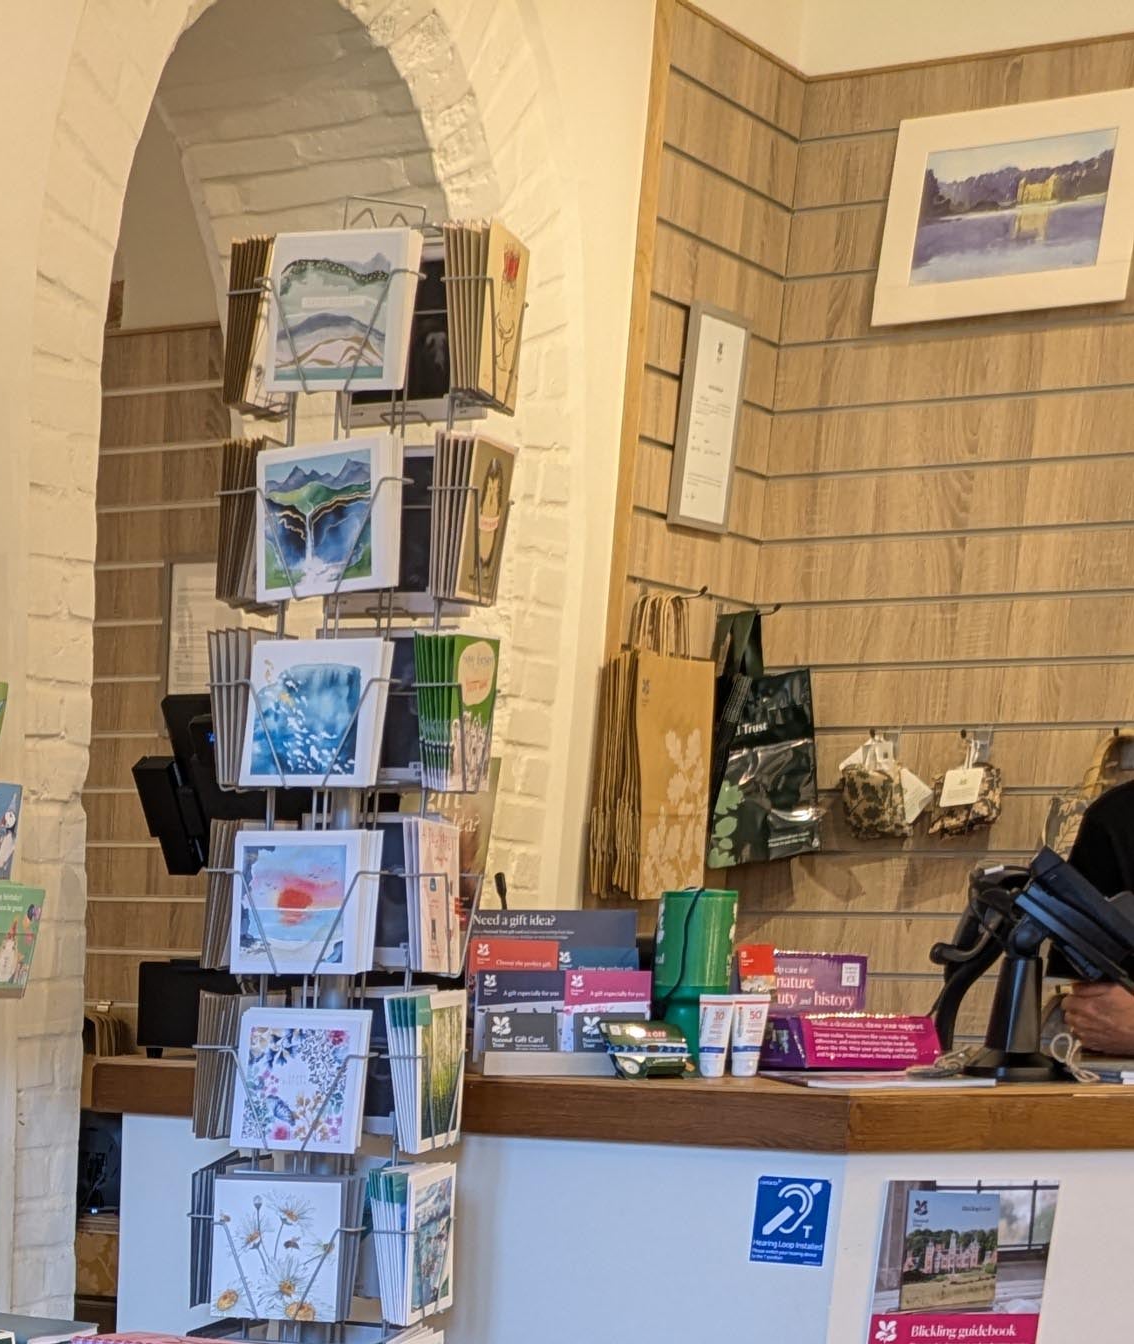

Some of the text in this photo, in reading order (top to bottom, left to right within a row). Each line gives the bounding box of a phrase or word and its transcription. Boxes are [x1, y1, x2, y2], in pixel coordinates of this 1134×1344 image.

[743, 722, 768, 734] Trust
[472, 914, 556, 928] Need a gift idea?
[798, 966, 808, 974] for
[776, 976, 814, 989] nature
[814, 991, 854, 1009] history
[753, 1240, 777, 1249] Hearing
[911, 1324, 1016, 1339] Blickling guidebook
